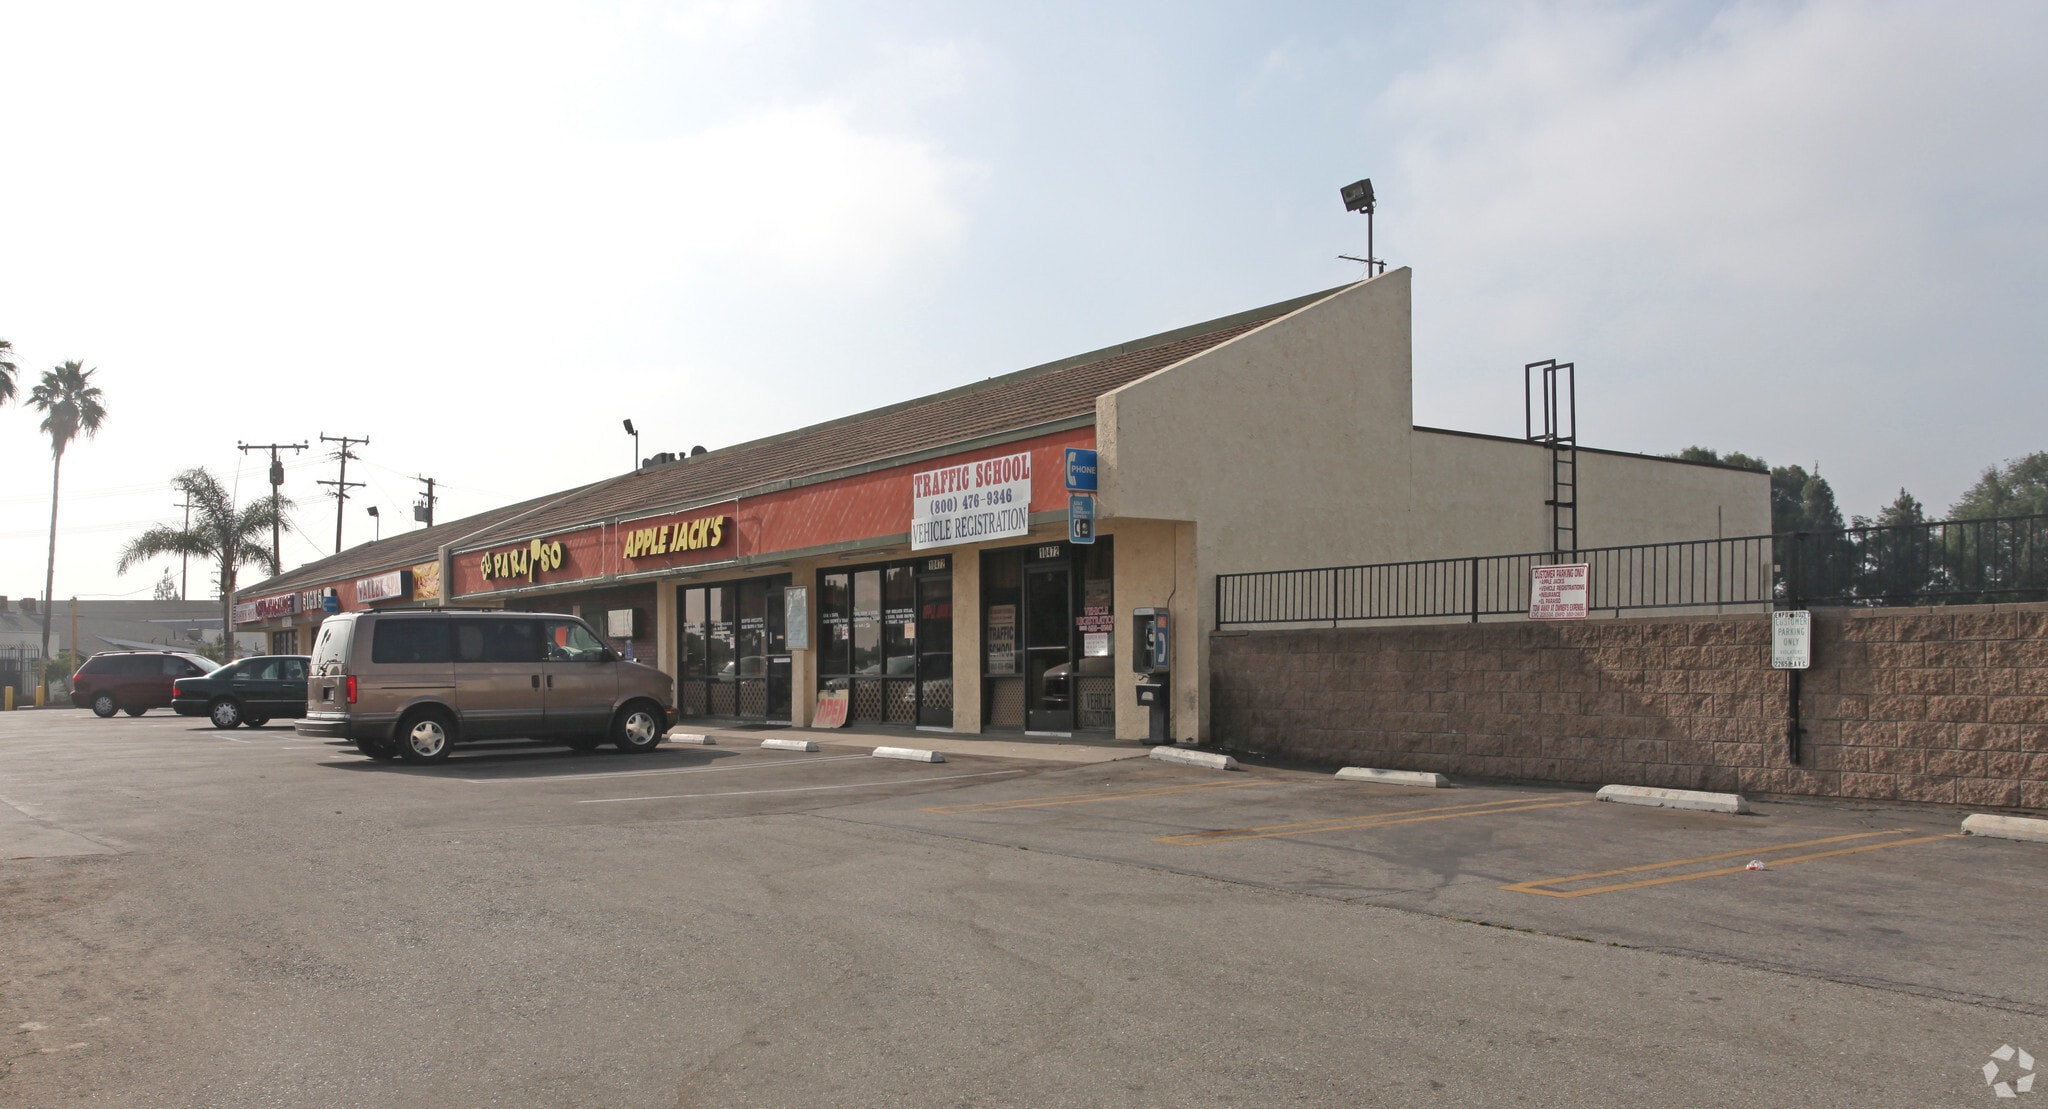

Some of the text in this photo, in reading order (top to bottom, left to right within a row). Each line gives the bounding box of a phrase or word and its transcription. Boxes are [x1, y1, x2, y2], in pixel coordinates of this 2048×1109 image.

[915, 455, 1030, 498] TRAFFIC SCHOOL
[1071, 464, 1097, 475] PHONE
[930, 488, 1012, 516] (800) 476-9346
[913, 507, 1027, 544] VEHICLE REGISTRATION
[623, 515, 724, 559] APPLE JACK'S
[1535, 568, 1584, 579] CUSTOMER PARKING ONLY
[1776, 618, 1808, 626] CUSTOMER
[989, 626, 1014, 640] TRAFFIC
[1778, 627, 1805, 636] PARKING
[1783, 638, 1800, 646] ONLY
[1086, 693, 1112, 710] VEHICLE
[817, 698, 847, 725] OPEN
